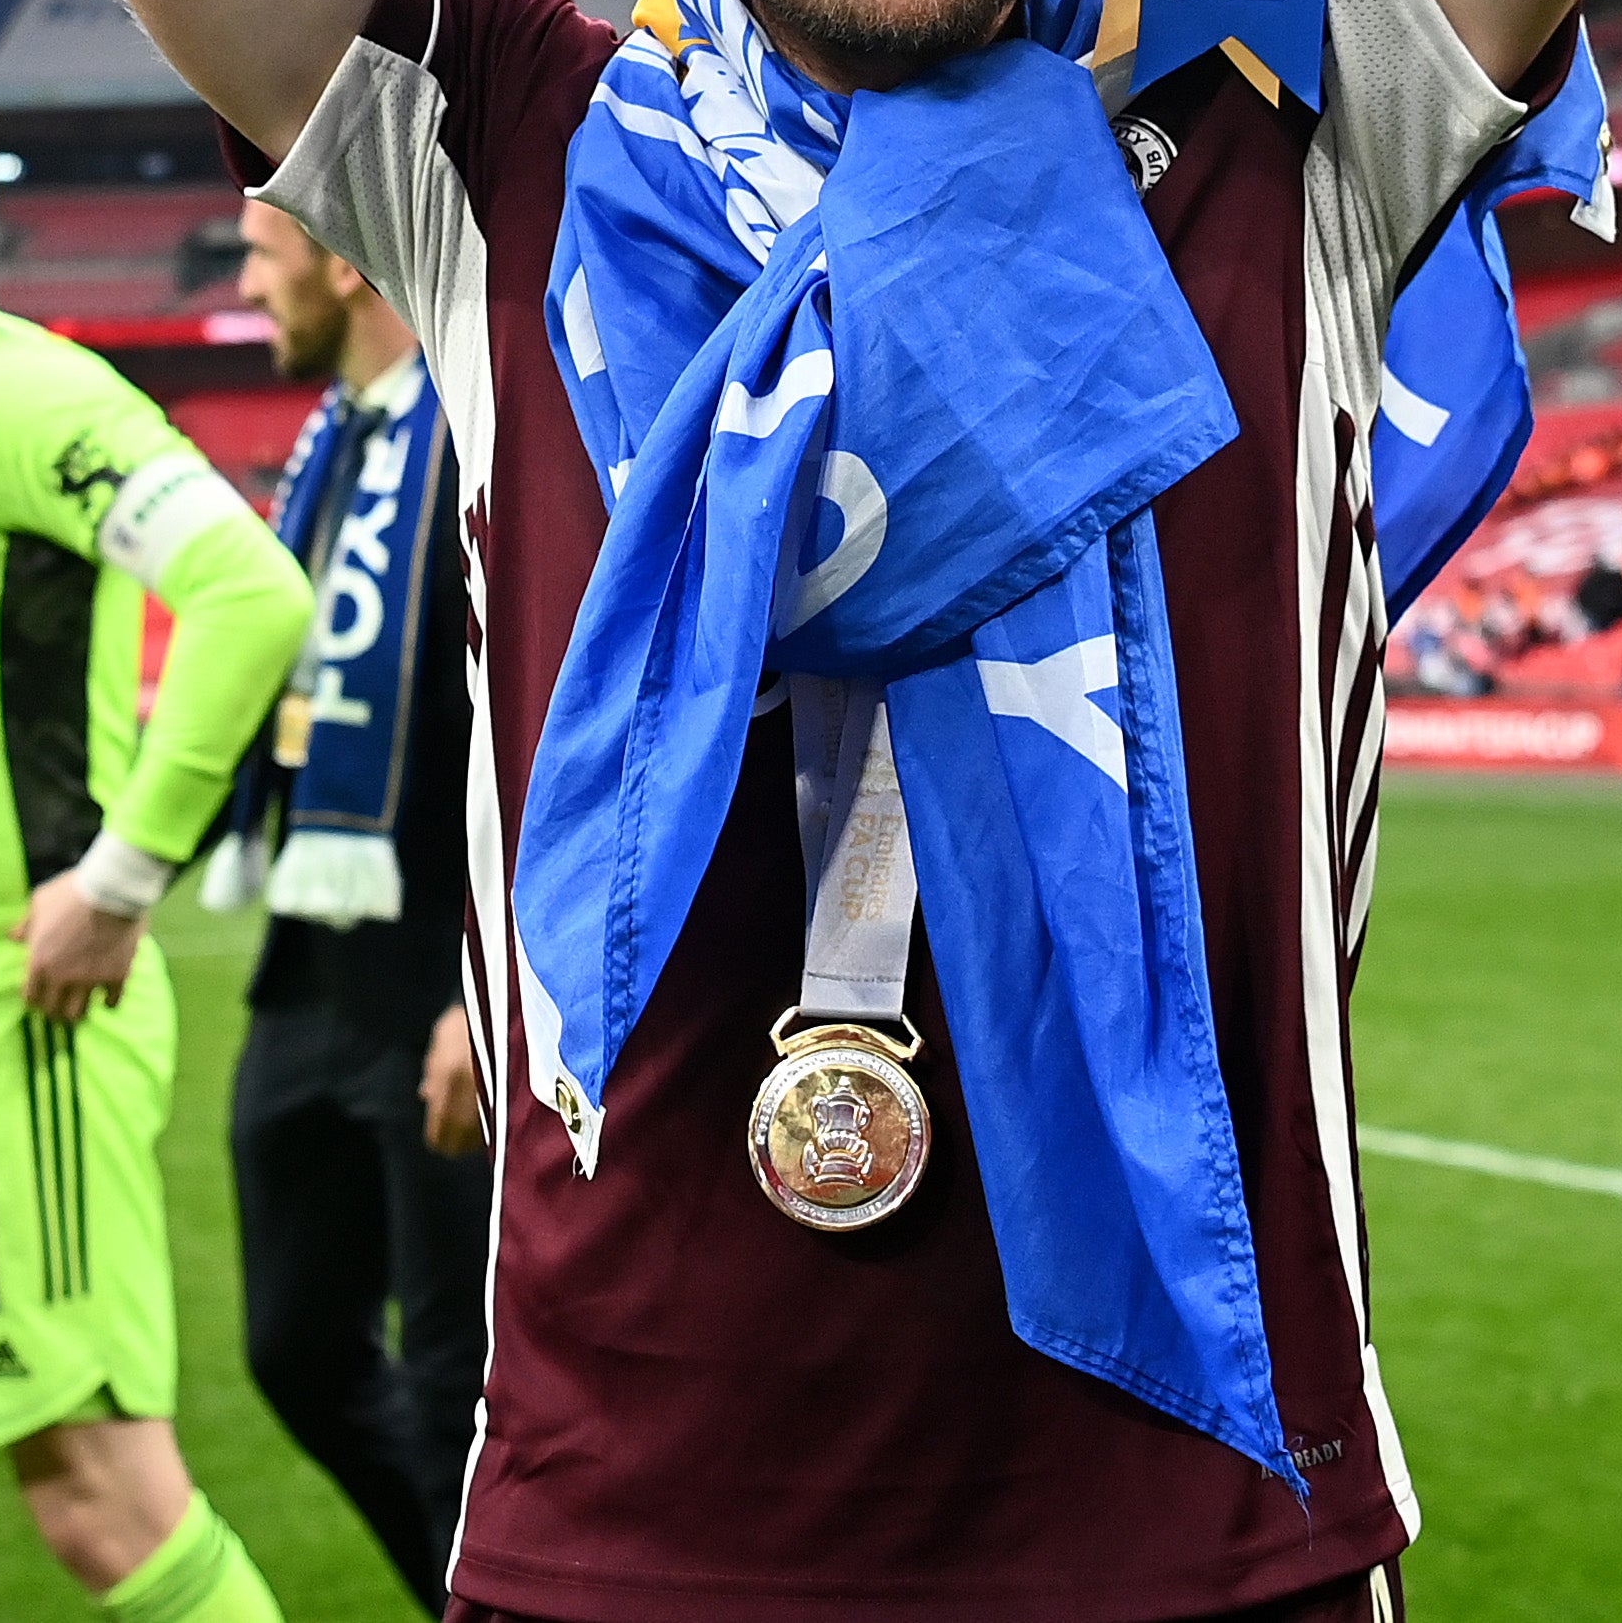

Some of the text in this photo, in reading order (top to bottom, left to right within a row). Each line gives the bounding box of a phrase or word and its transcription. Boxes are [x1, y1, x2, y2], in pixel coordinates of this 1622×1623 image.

[838, 811, 877, 923] FA CUP
[865, 813, 903, 921] Emirates
